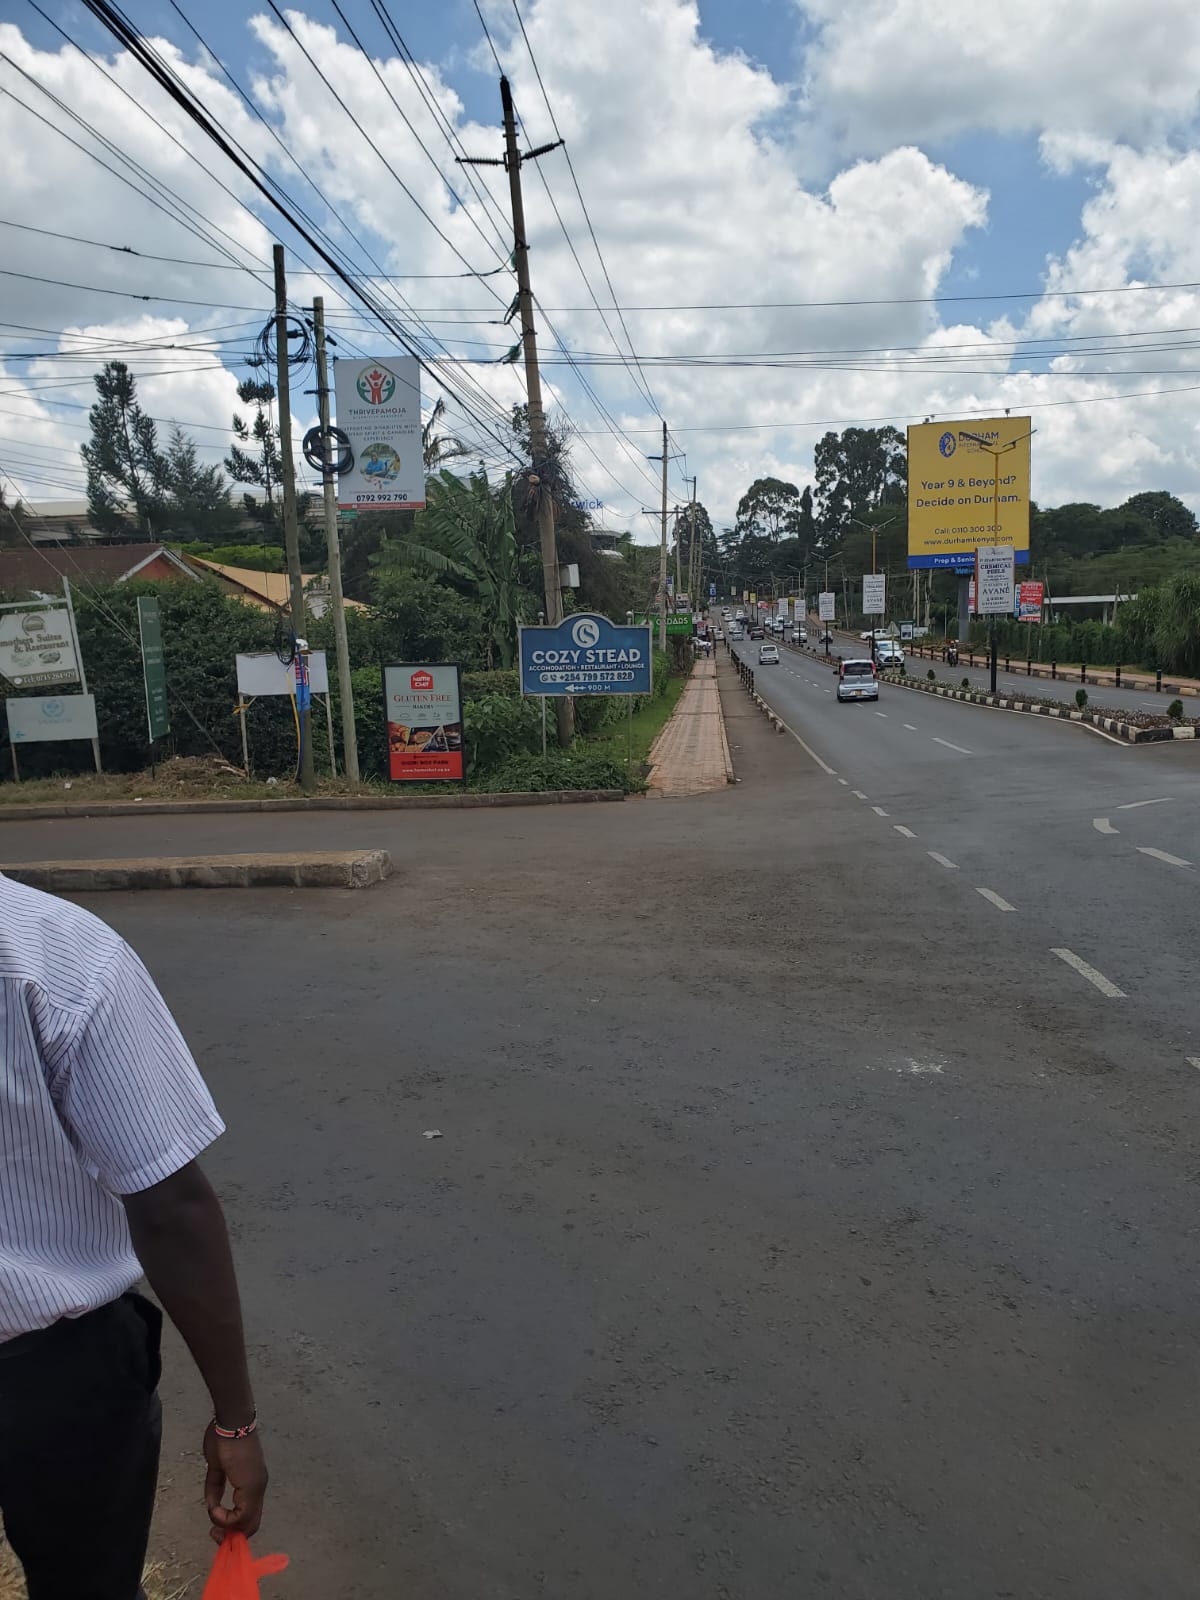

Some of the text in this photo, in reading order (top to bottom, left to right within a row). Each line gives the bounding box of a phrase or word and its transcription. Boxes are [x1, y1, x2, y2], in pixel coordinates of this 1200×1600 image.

[348, 408, 406, 416] THRIVEPAMOJA
[922, 476, 1016, 490] Year 9 & Beyond?
[916, 496, 954, 508] Decide
[958, 496, 971, 504] on
[924, 535, 1013, 544] www.durhamkenyacom
[656, 617, 688, 626] CDARS
[26, 641, 69, 652] Restaurant
[532, 648, 640, 664] COZY STEAD
[560, 672, 580, 682] +254
[600, 672, 614, 680] 572
